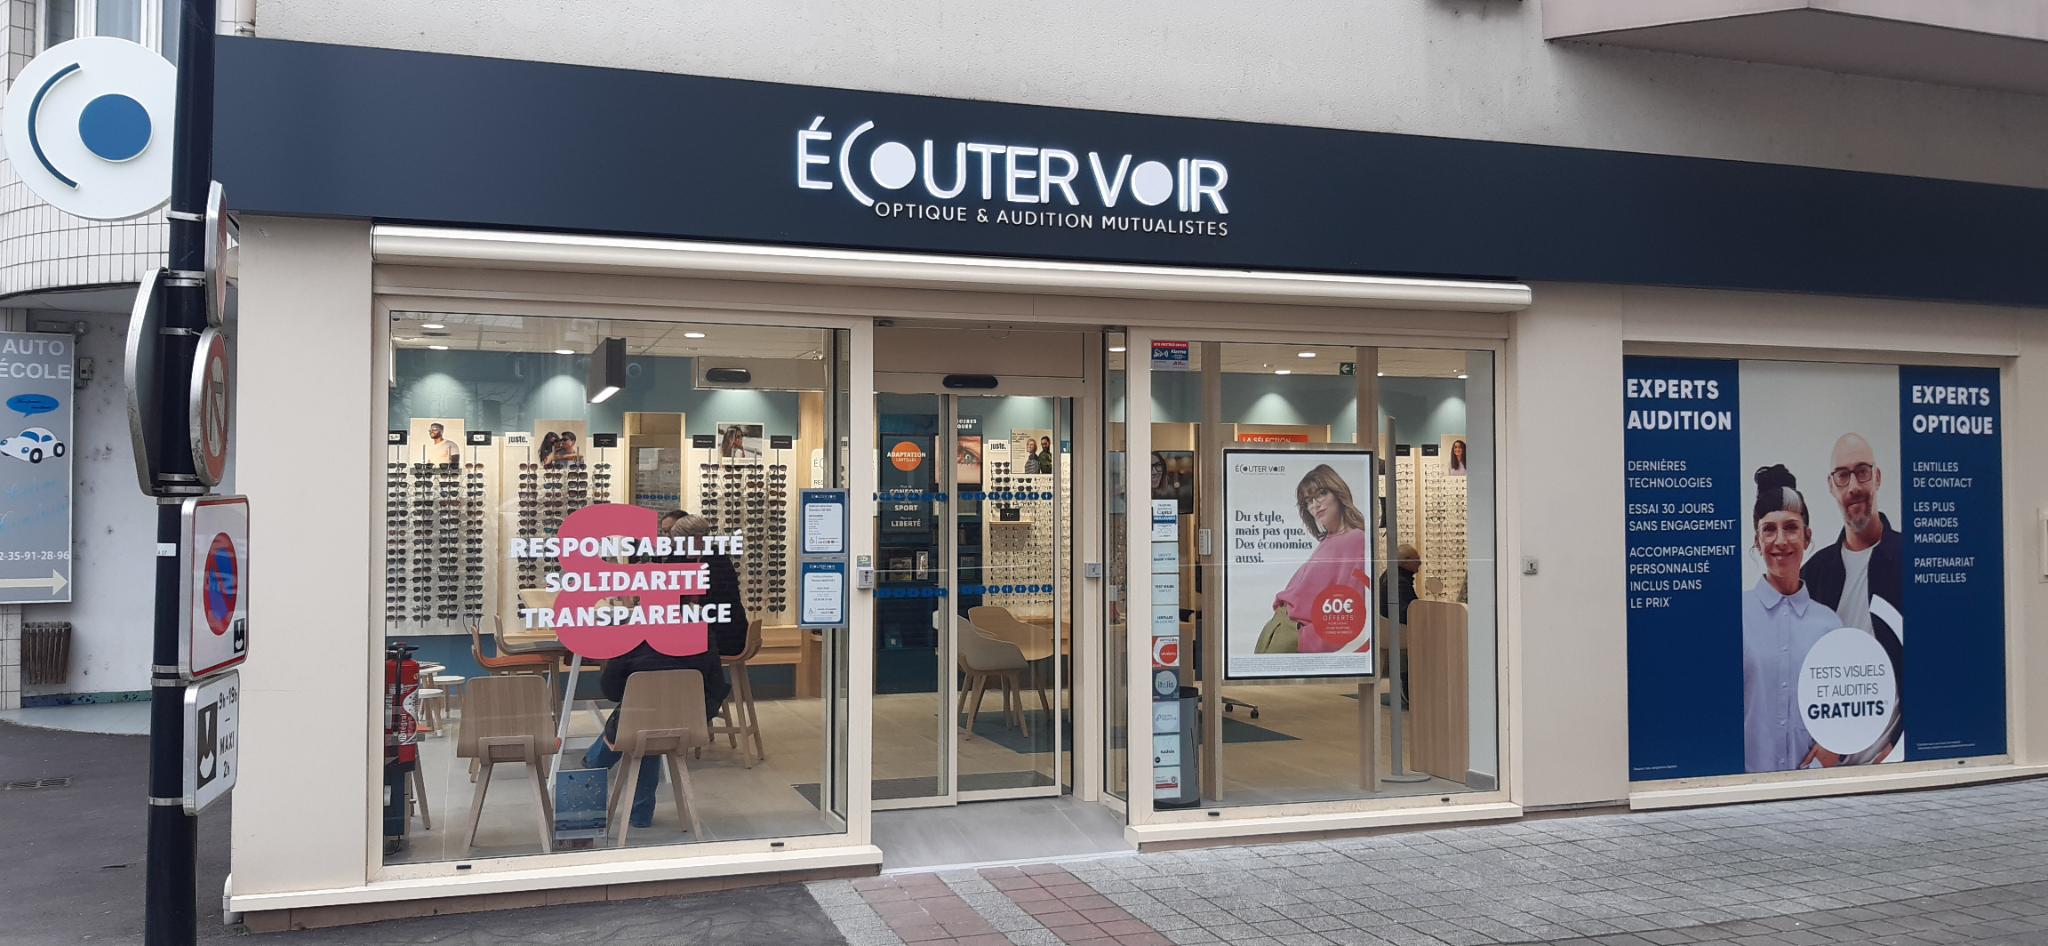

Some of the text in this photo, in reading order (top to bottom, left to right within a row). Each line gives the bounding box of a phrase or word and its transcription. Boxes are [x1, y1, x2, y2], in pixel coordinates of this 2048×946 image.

[798, 116, 1229, 215] ÉCOUTER VOIR
[874, 202, 1229, 237] OPTIQUE & AUDITION MUTUALISTES
[2, 338, 65, 356] AUTO
[0, 358, 71, 379] ÉCOLE
[1627, 378, 1719, 400] EXPERTS
[1912, 385, 1990, 406] EXPERTS
[1627, 410, 1732, 431] AUDITION
[1912, 414, 1993, 435] OPTIQUE
[1268, 465, 1286, 473] VOIR
[1628, 459, 1687, 471] DERNIÈRES
[1913, 461, 1959, 472] LENTILLES
[1628, 477, 1713, 488] TECHNOLOGIES
[1913, 477, 1973, 488] DE CONTACT
[1629, 503, 1715, 514] ESSAI 30 JOURS
[1913, 502, 1955, 512] LES PLUS
[891, 518, 921, 527] LIBERTÉ
[1235, 510, 1284, 526] Du style,
[1913, 517, 1959, 528] GRANDES
[1235, 524, 1306, 540] mais pas que.
[1629, 520, 1658, 531] SANS
[509, 529, 744, 558] RESPONSABILITÉ
[1235, 537, 1313, 550] Des économies
[1914, 533, 1960, 543] MARQUES
[1235, 552, 1264, 563] aussi.
[1629, 545, 1736, 557] ACCOMPAGNEMENT
[1630, 560, 1710, 574] PERSONNALISÉ
[1914, 557, 1975, 568] PARTENARIAT
[545, 562, 711, 592] SOLIDARITÉ
[1914, 572, 1967, 584] MUTUELLES
[1630, 579, 1702, 591] INCLUS DANS
[1322, 598, 1354, 613] 60€
[1630, 598, 1643, 609] LE
[520, 603, 732, 628] TRANSPARENCE
[1810, 664, 1886, 679] TESTS VISUELS
[1817, 682, 1879, 698] ET AUDITIFS
[220, 731, 235, 756] MAXI
